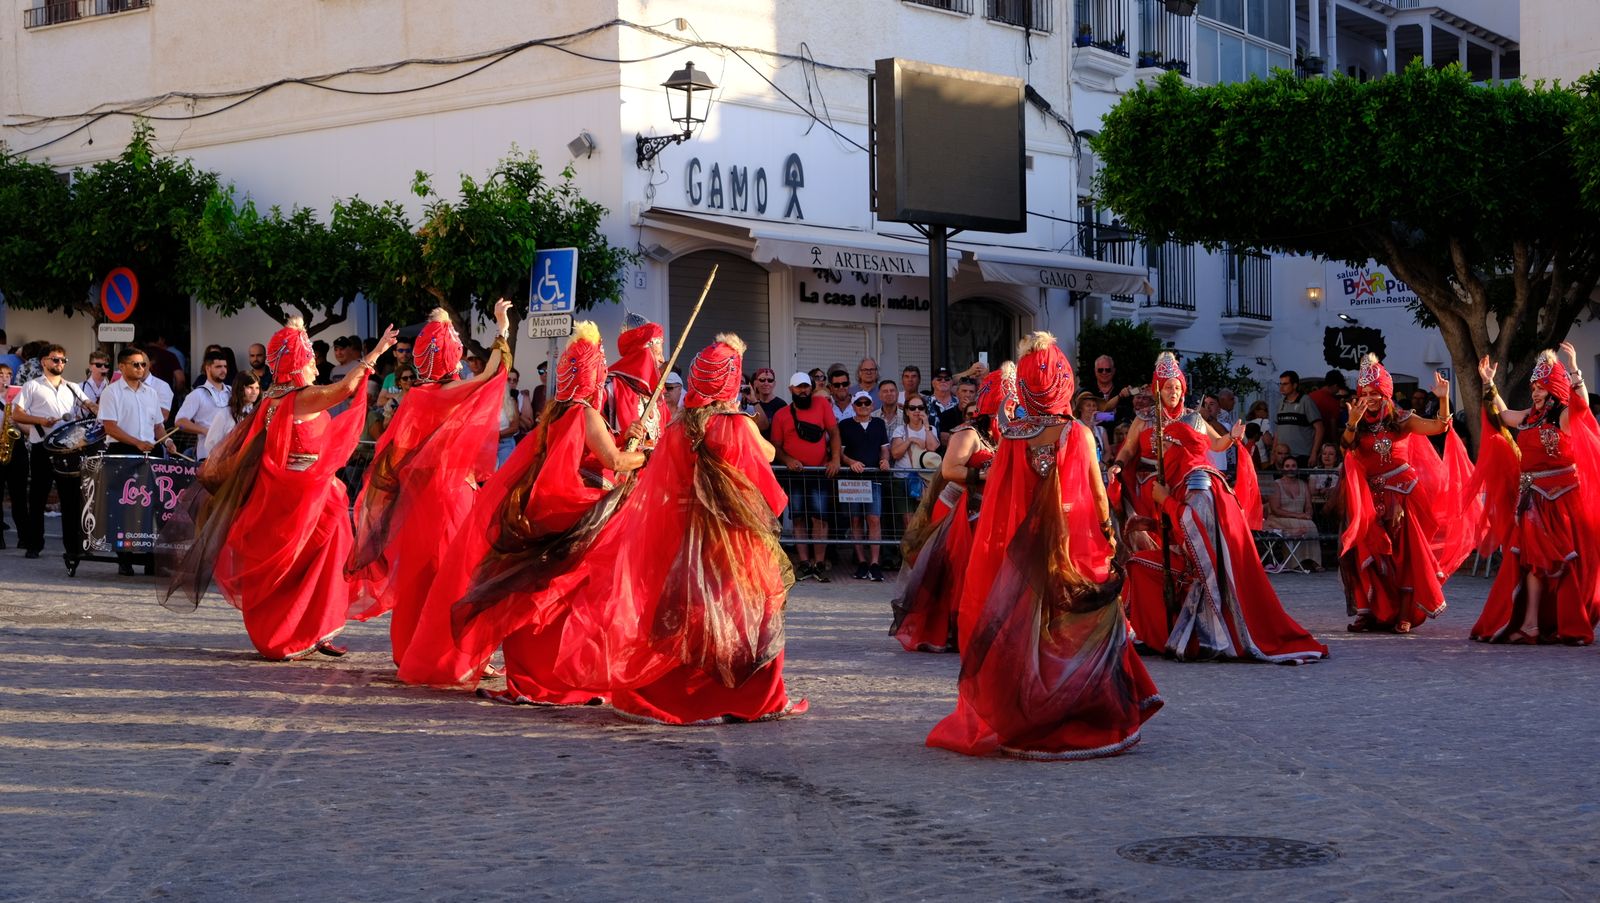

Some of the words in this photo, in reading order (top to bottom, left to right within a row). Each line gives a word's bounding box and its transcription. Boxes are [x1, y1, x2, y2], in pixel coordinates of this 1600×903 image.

[686, 157, 768, 215] GAMO
[834, 251, 916, 274] ARTESANIA
[1039, 269, 1077, 289] GAMO
[1336, 268, 1359, 280] salud
[1365, 267, 1370, 277] y
[800, 281, 819, 304] La
[823, 291, 856, 307] casa
[532, 316, 568, 327] Máximo
[532, 329, 538, 337] 2
[540, 327, 567, 337] Horas
[151, 463, 183, 475] GRUPO
[119, 477, 153, 507] Los
